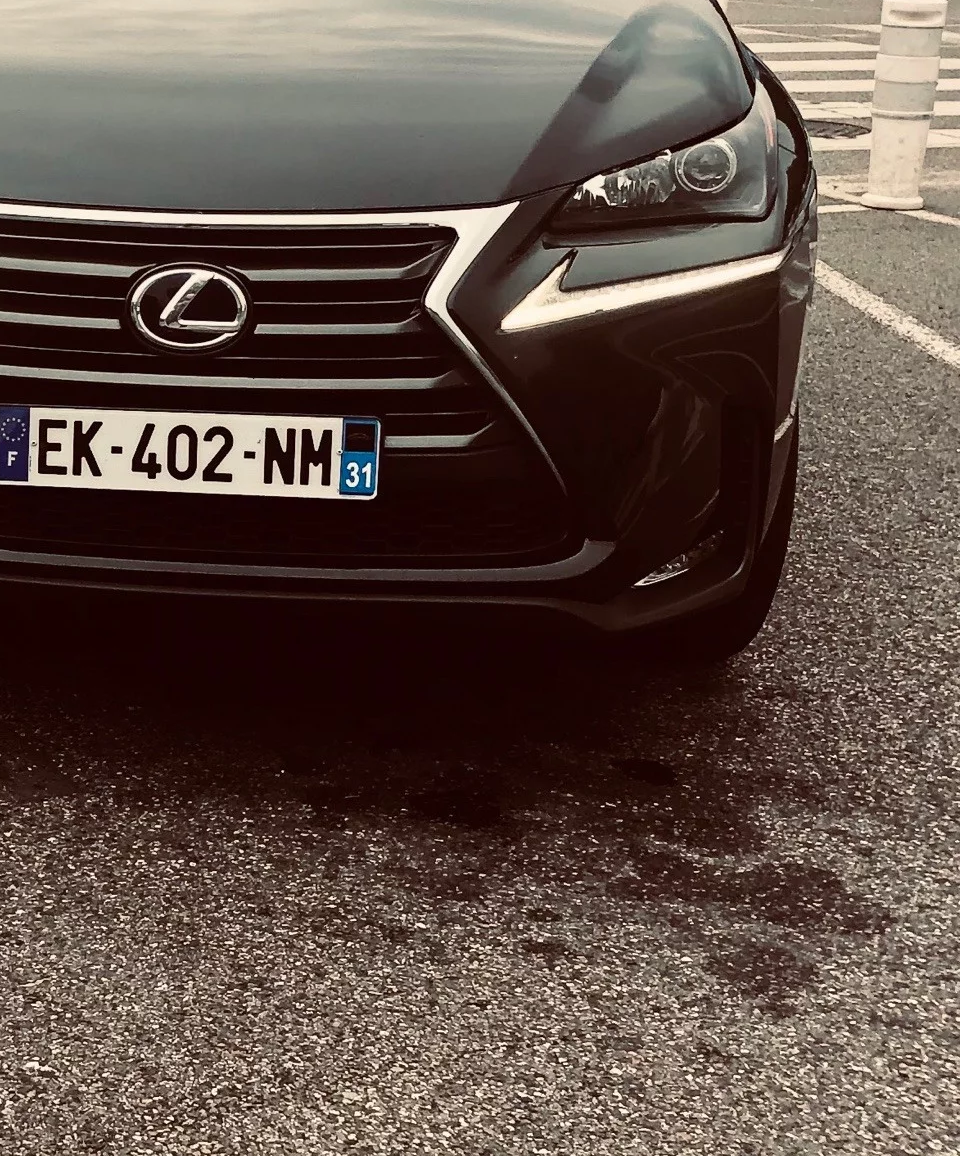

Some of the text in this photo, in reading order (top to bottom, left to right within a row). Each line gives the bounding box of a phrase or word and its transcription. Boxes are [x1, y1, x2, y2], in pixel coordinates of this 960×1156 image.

[7, 418, 372, 489] F EK-402-NM 31
